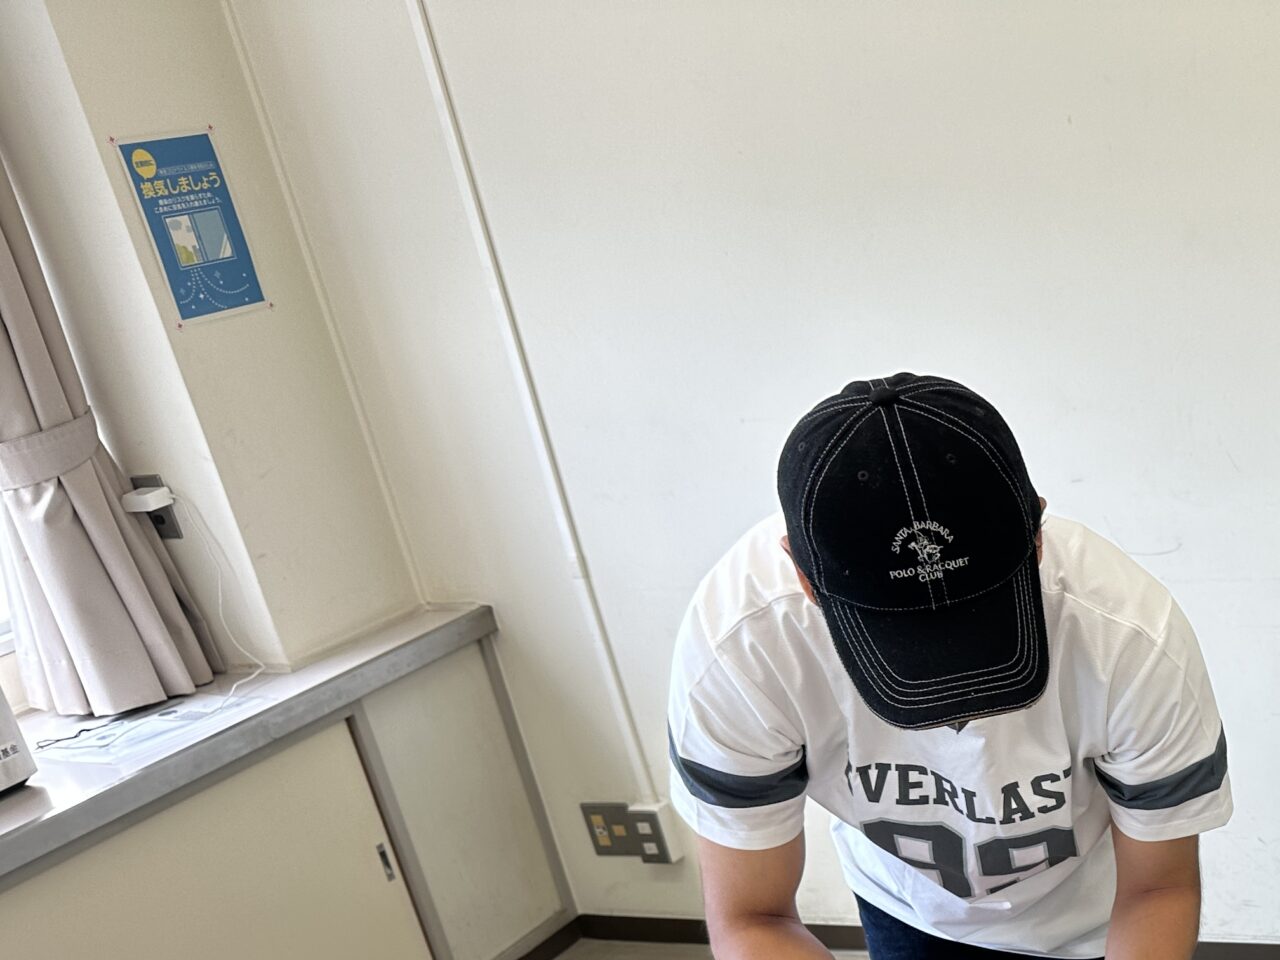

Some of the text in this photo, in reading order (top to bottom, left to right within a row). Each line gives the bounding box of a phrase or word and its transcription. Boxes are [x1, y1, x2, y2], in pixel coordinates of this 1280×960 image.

[141, 172, 220, 198] 換気しましょう
[891, 521, 954, 554] SANTA BARBARA
[889, 568, 915, 579] POLO
[926, 557, 969, 573] RACQUET
[919, 571, 943, 582] CLUB
[845, 759, 1073, 825] VERLAS
